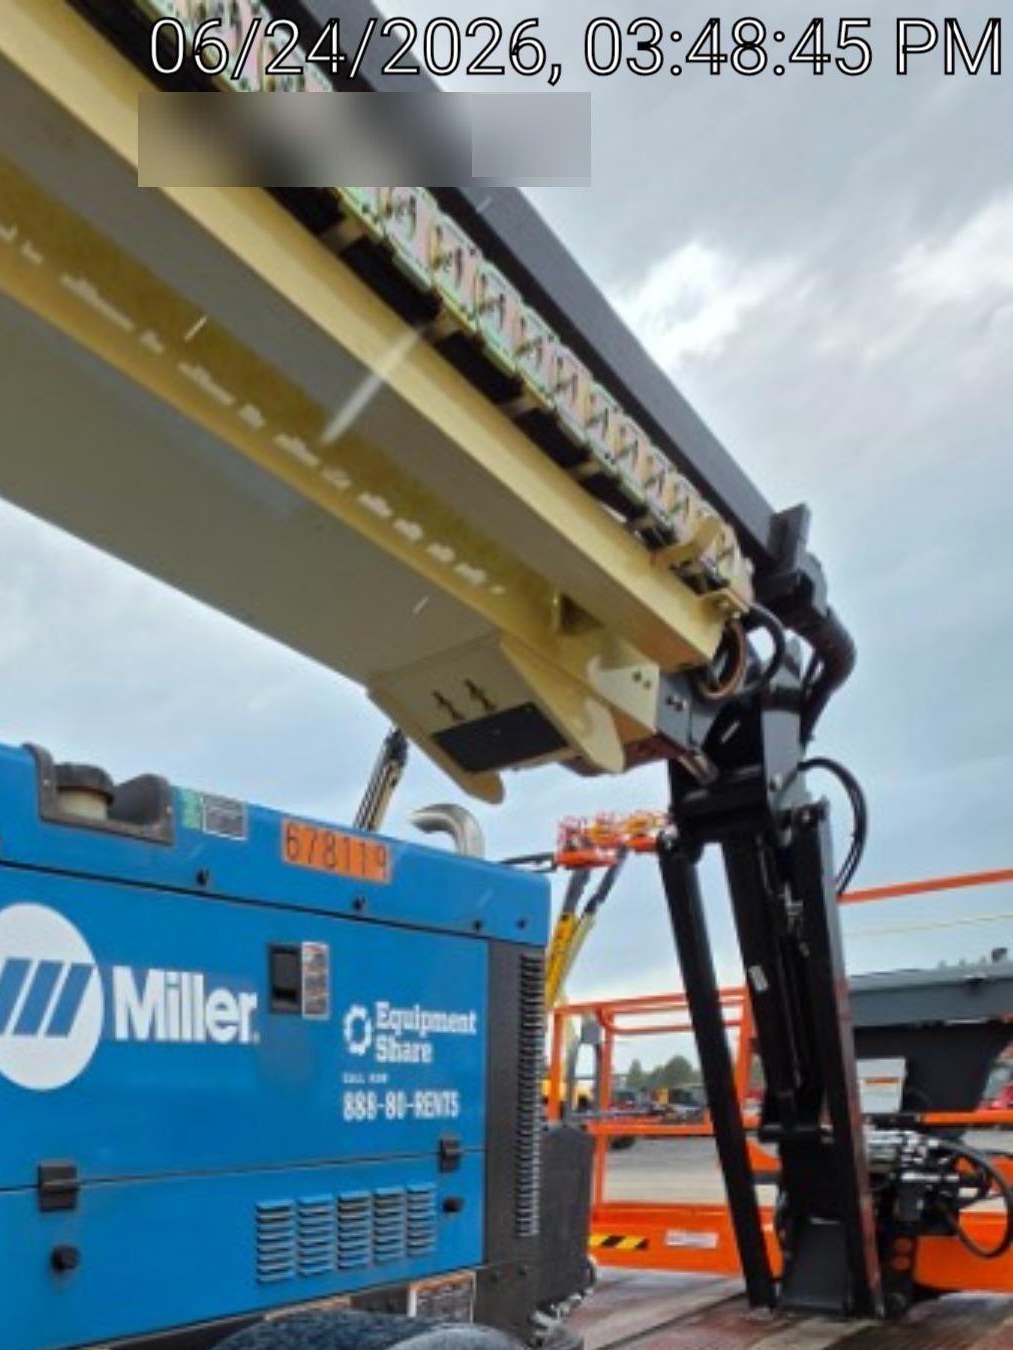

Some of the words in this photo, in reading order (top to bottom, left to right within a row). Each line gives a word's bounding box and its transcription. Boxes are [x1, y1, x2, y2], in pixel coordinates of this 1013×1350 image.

[285, 820, 387, 879] 678119
[112, 964, 259, 1045] Miller
[375, 1000, 477, 1038] Equipment
[375, 1033, 432, 1063] Share
[343, 1091, 459, 1121] 888-80-RENTS
